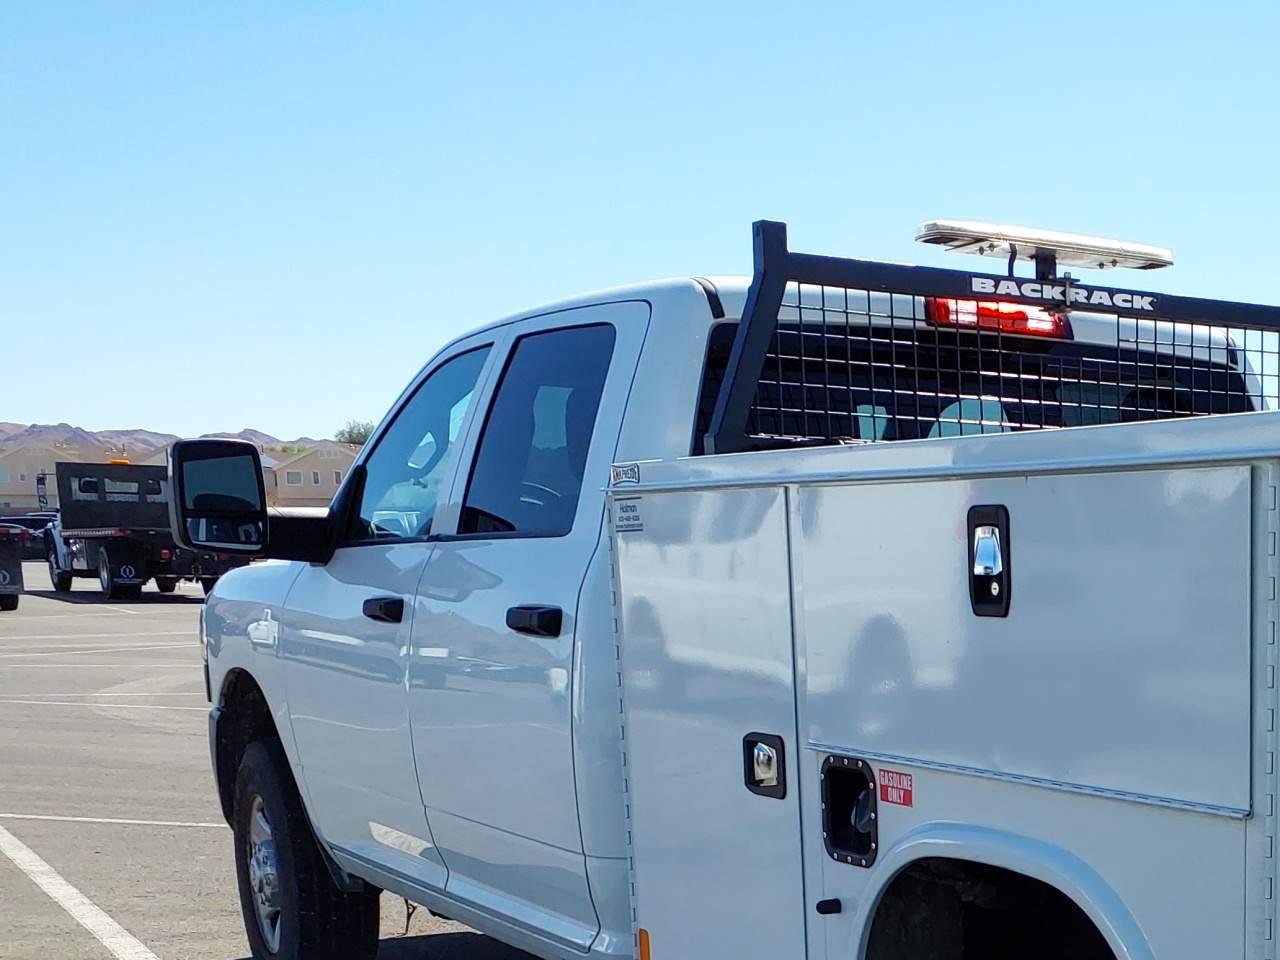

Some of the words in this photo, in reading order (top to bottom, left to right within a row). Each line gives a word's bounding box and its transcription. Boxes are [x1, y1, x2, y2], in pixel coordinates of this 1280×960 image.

[971, 276, 1155, 310] BACKRACK
[880, 770, 912, 791] GASOLINE
[887, 787, 904, 804] ONLY
